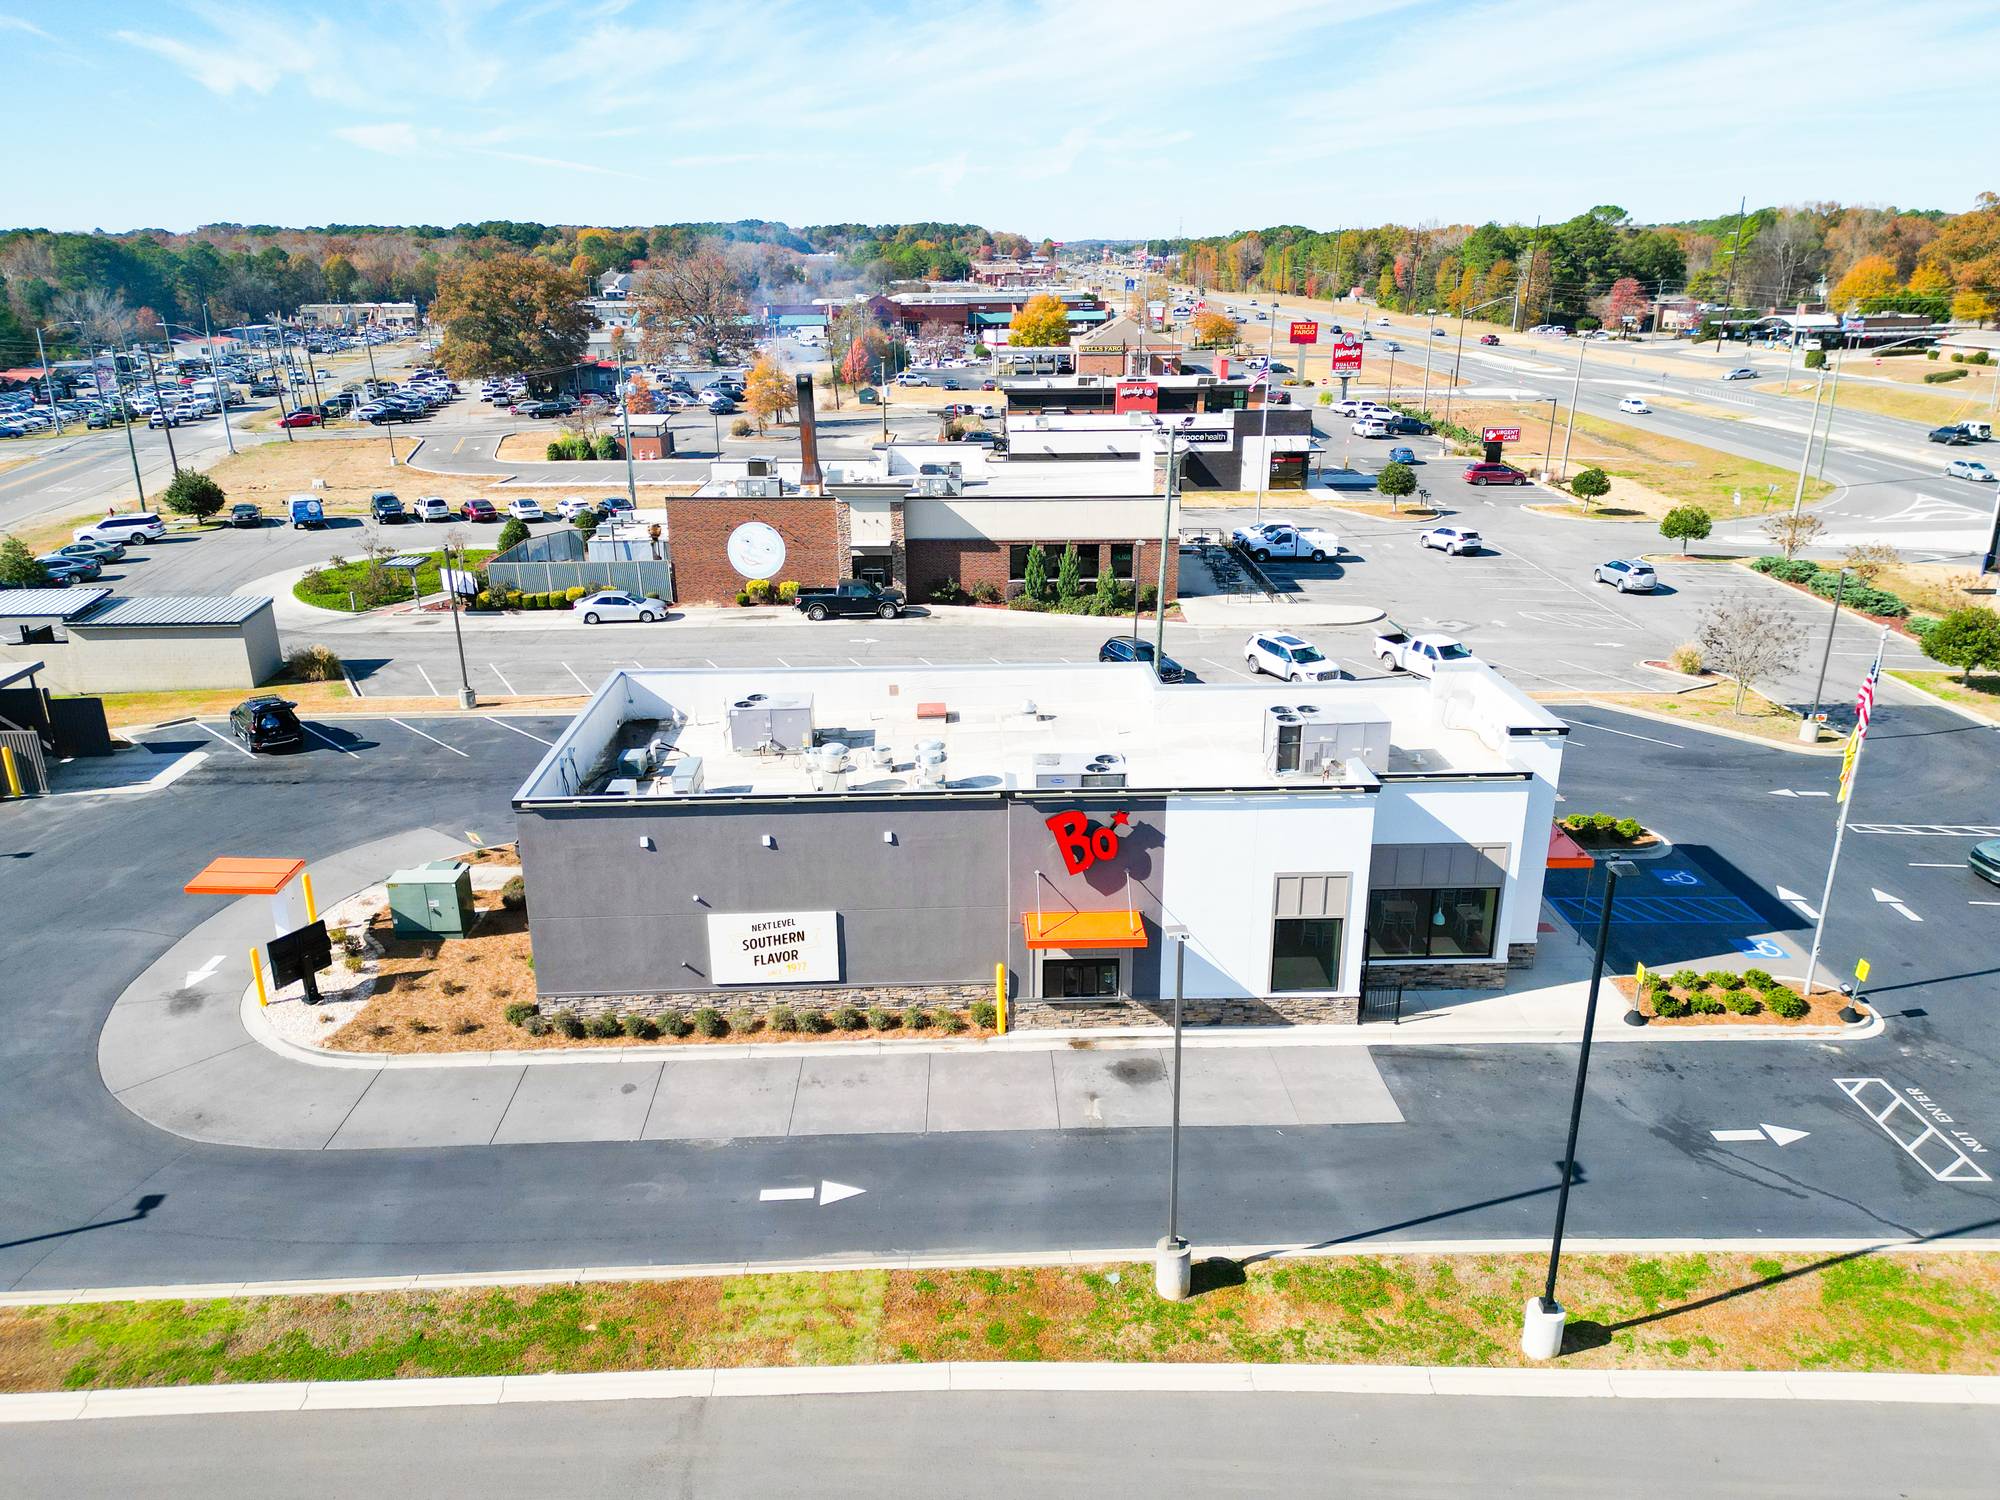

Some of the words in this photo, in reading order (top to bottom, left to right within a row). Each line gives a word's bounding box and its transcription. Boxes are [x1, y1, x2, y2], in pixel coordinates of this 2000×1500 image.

[751, 922, 772, 932] NEXT
[773, 918, 796, 929] LEVEL
[742, 930, 805, 951] SOUTHERN
[753, 949, 799, 967] FLAVOR
[1905, 1087, 1954, 1122] ENTER
[1950, 1130, 1989, 1152] NOT
